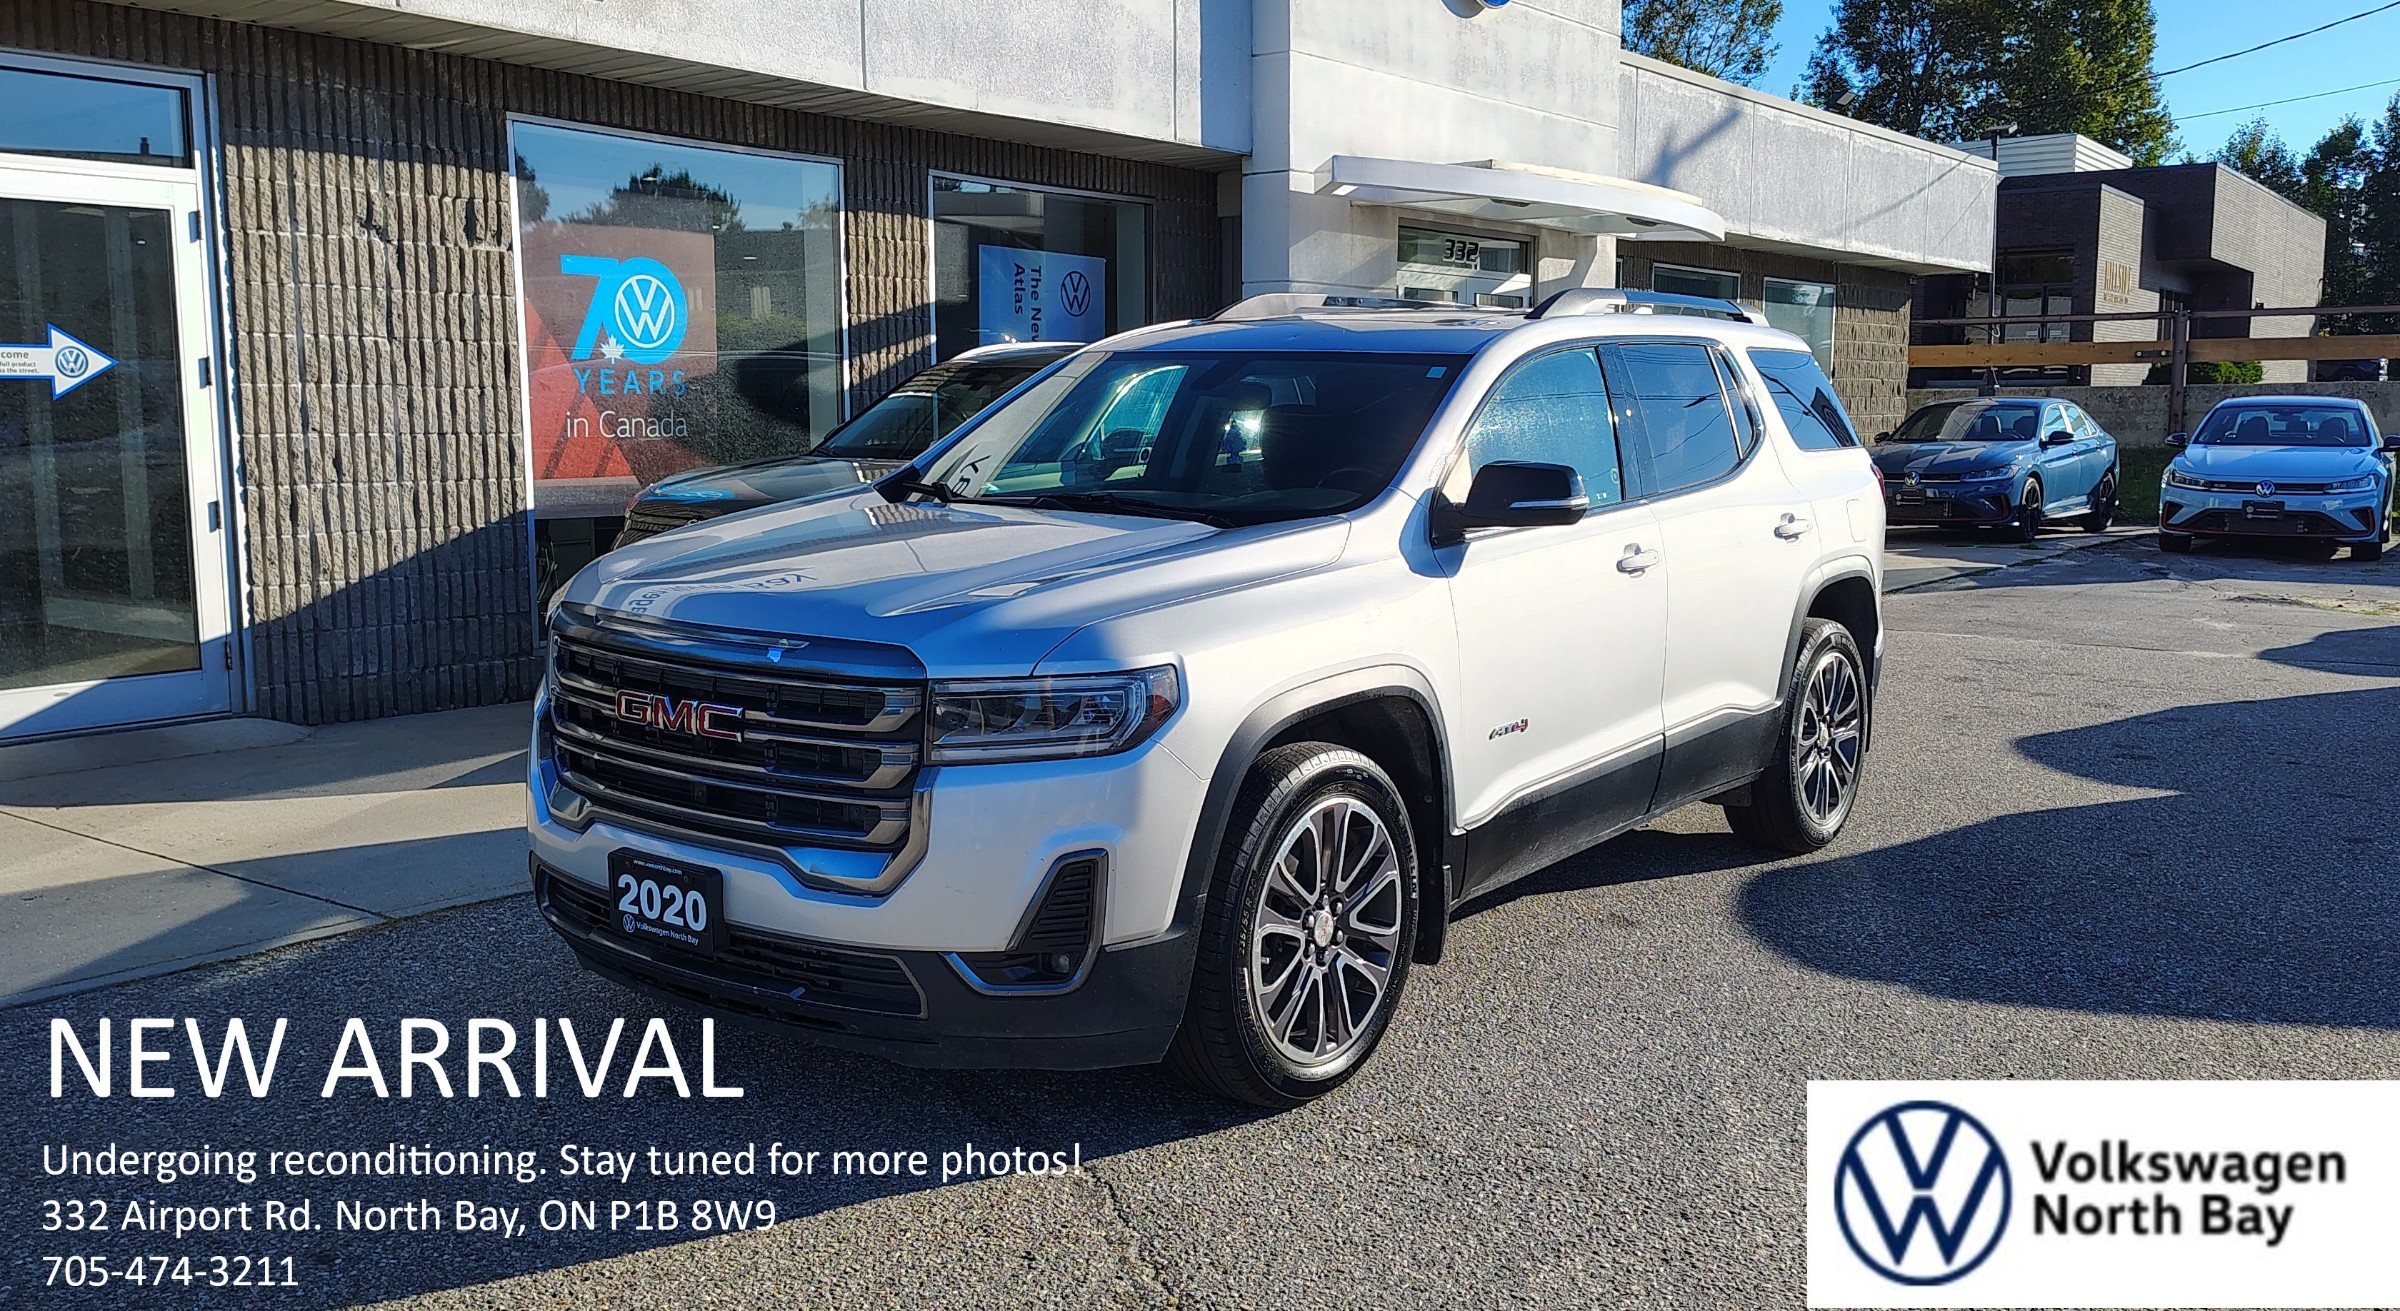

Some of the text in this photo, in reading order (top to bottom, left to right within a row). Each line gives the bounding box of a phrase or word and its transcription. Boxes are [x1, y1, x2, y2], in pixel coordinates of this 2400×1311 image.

[1443, 238, 1479, 263] 332
[1013, 262, 1026, 315] Atlas
[1030, 265, 1042, 301] The
[573, 368, 687, 397] YEARS
[566, 410, 688, 438] in Canada
[615, 689, 744, 743] GMC
[618, 874, 707, 931] 2020
[636, 921, 699, 947] Volkswagen North Bay
